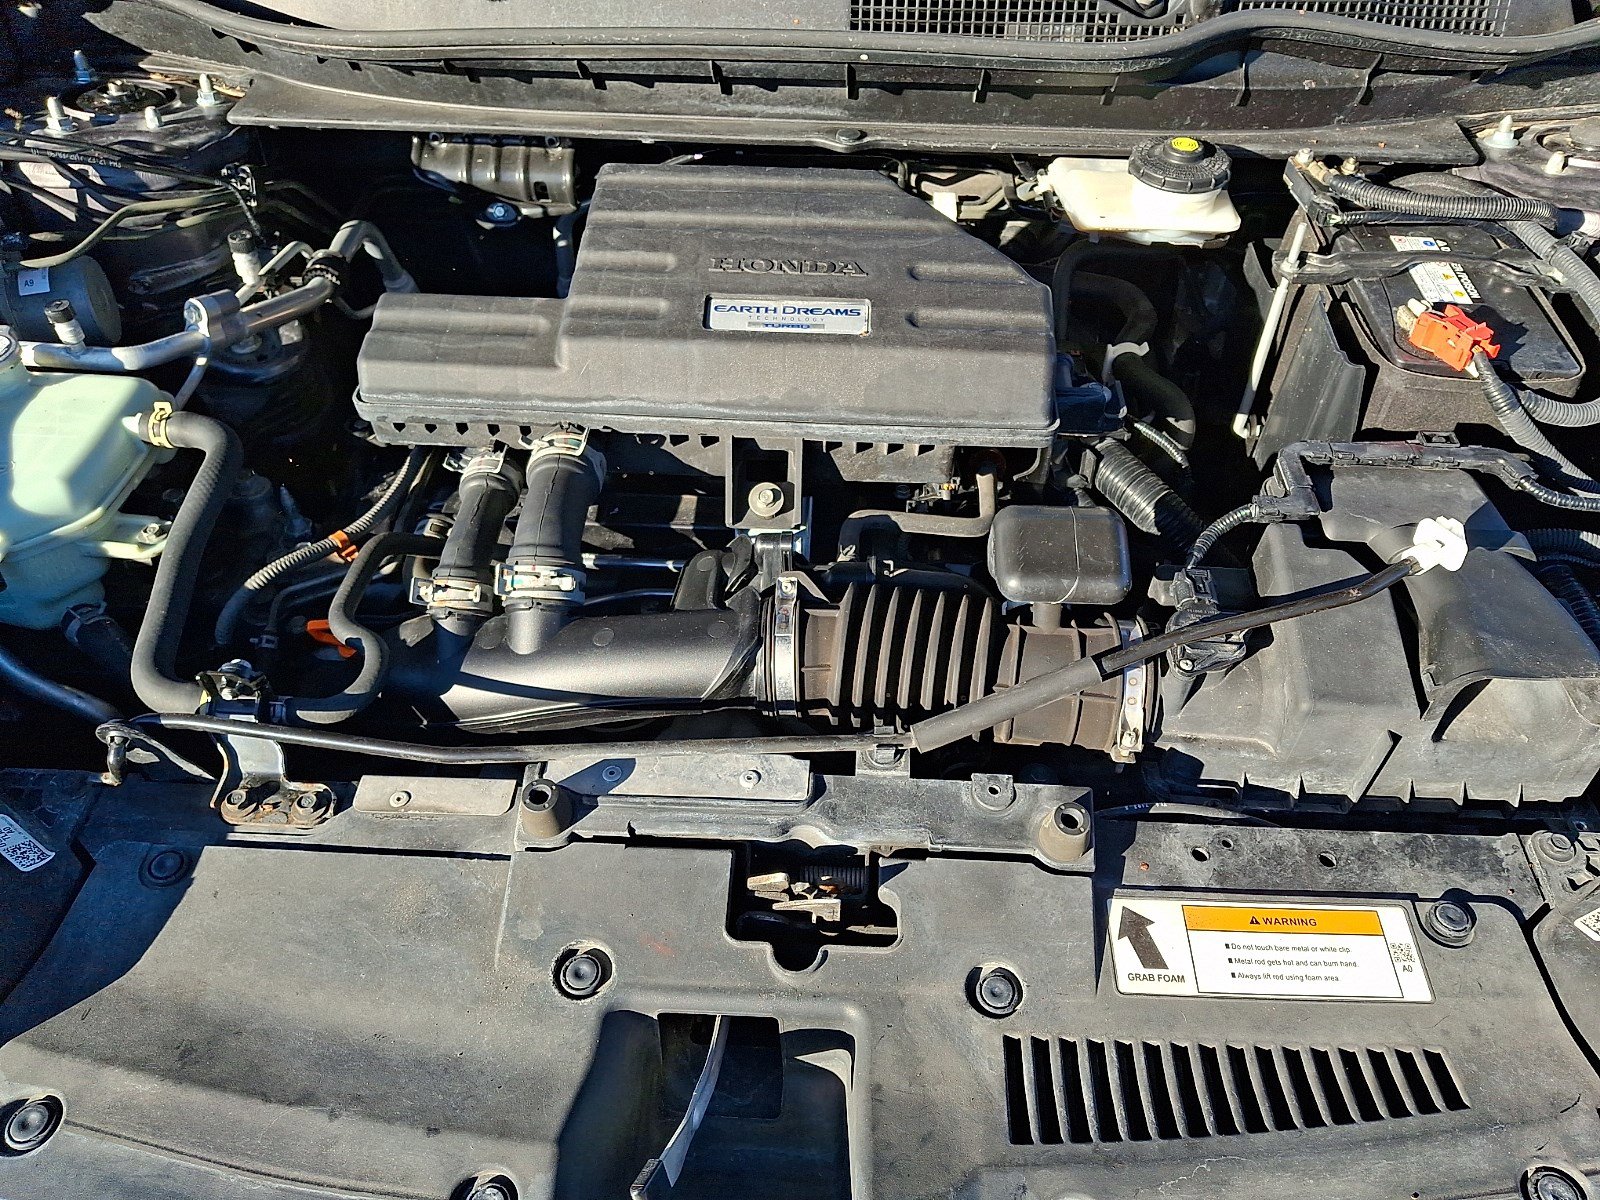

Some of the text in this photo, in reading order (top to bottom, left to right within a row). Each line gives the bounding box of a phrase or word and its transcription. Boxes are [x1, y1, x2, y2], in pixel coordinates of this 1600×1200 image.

[708, 257, 869, 277] HONDA
[24, 279, 35, 287] A9
[713, 305, 861, 316] EARTH DREAMS
[763, 322, 811, 330] TURBO
[1262, 917, 1318, 926] WARNING
[1231, 942, 1241, 950] Do
[1274, 944, 1290, 952] bare
[1319, 945, 1337, 953] white
[1234, 957, 1253, 965] Metal
[1266, 959, 1281, 967] gets
[1295, 959, 1309, 967] and
[1127, 972, 1186, 983] GRAB FOAM
[1237, 971, 1261, 981] Always
[1262, 972, 1272, 980] lift
[1272, 973, 1284, 981] rod
[1285, 973, 1304, 983] using
